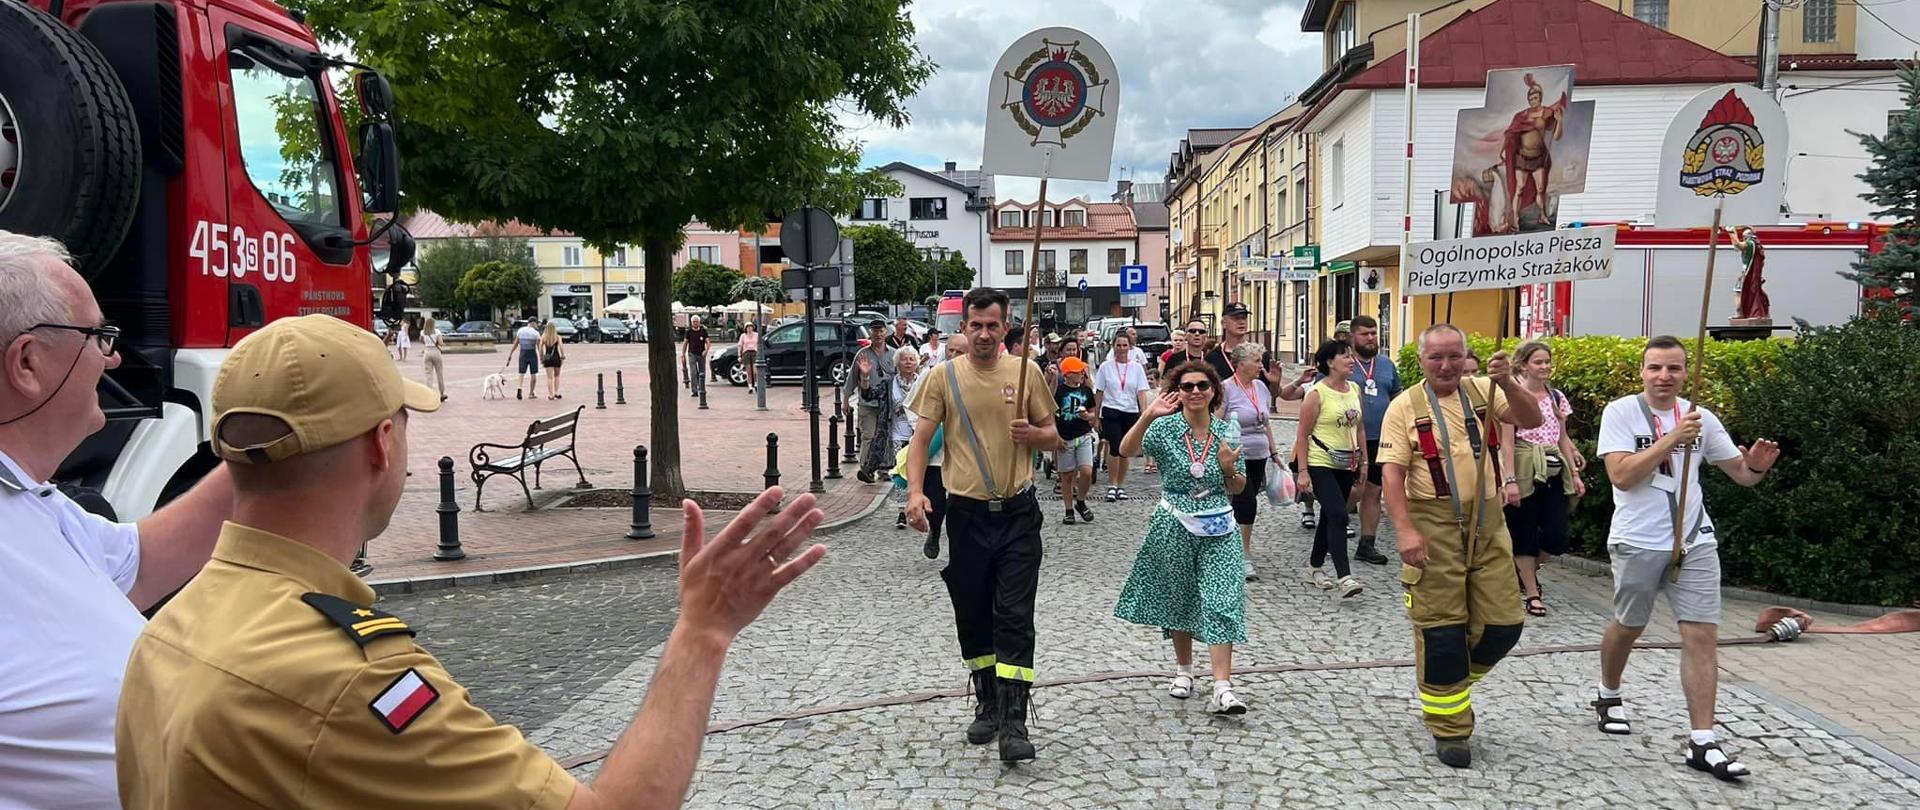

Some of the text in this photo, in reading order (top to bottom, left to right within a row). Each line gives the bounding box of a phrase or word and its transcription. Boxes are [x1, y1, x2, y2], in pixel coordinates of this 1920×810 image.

[1421, 234, 1602, 266] Ogólnopolska Piesza
[1126, 268, 1142, 290] P
[1408, 255, 1610, 288] Pielgrzymka Strażaków
